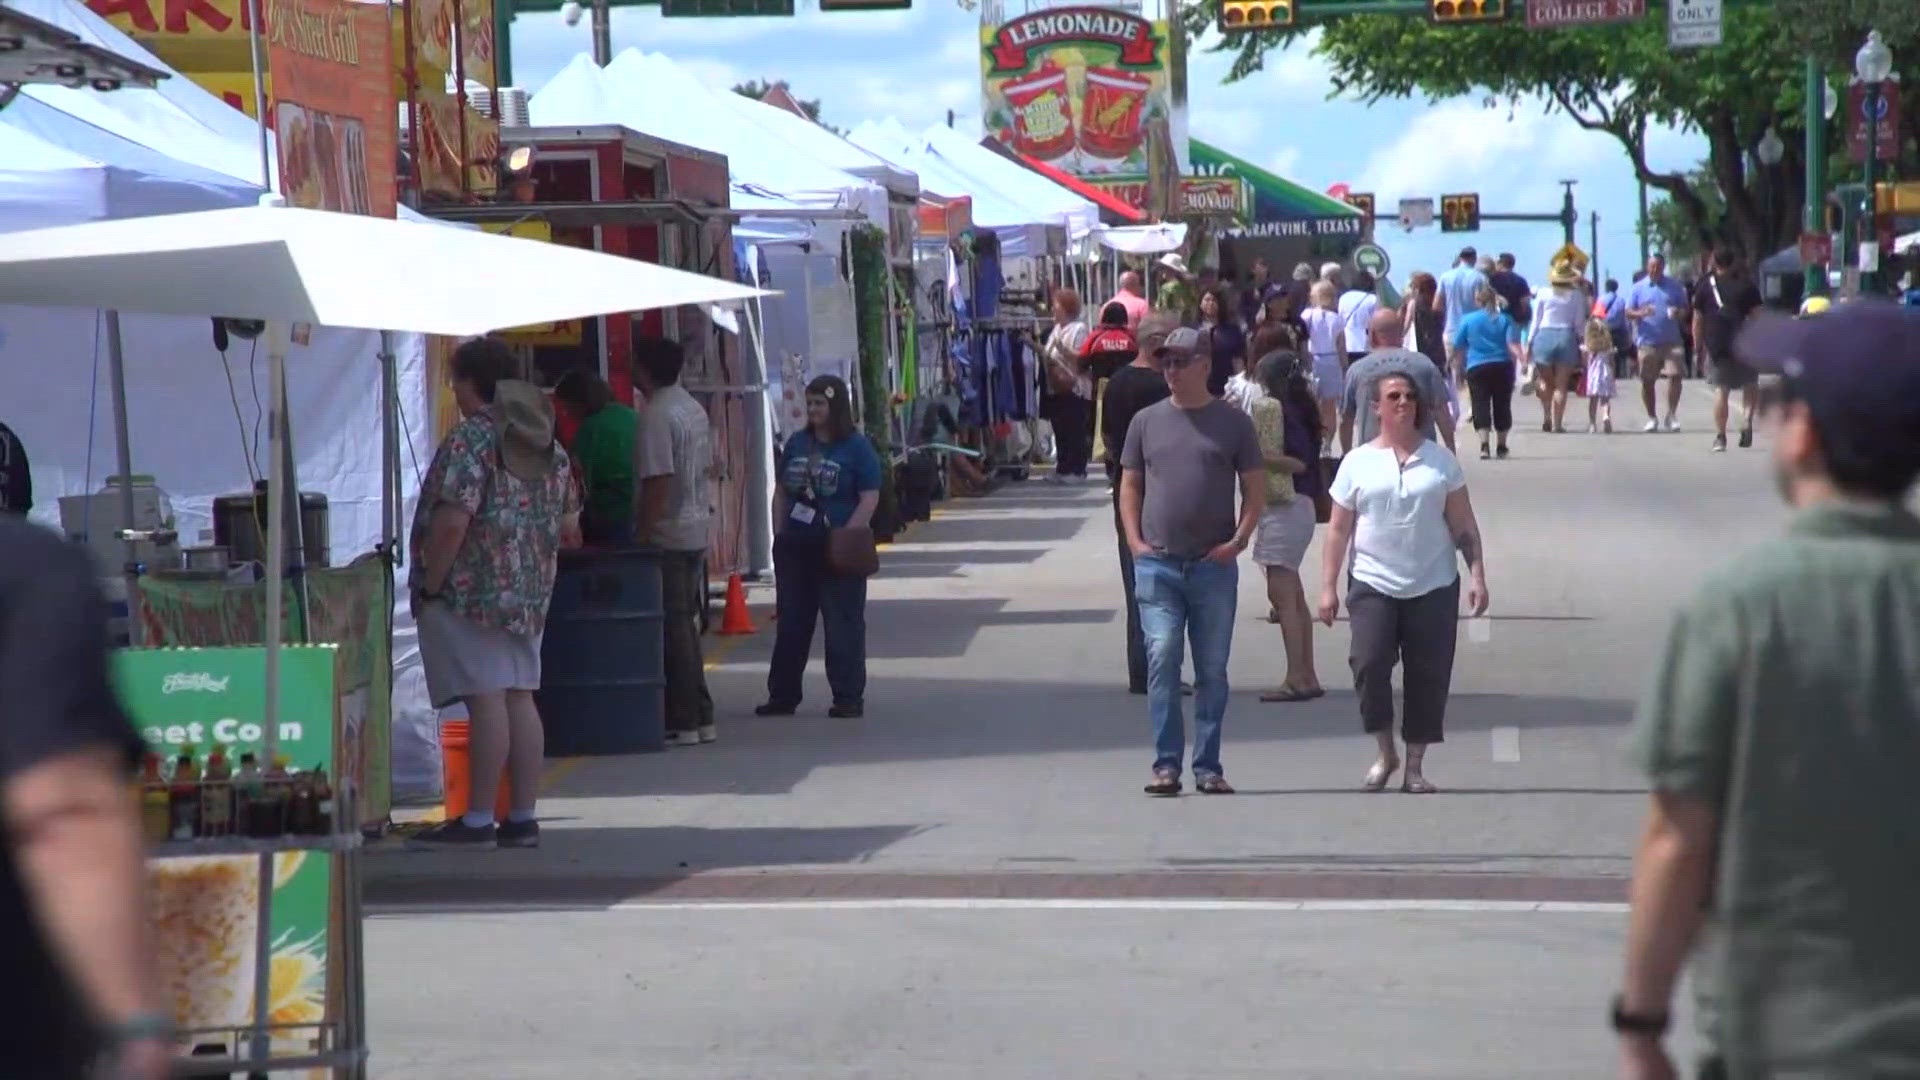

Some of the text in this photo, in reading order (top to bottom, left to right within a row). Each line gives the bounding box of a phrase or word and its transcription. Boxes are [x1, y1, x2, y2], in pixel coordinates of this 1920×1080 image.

[1534, 1, 1634, 22] COLLEGE ST
[1677, 7, 1714, 20] ONLY
[1007, 13, 1140, 45] LEMONADE
[1316, 219, 1349, 235] TEXAS
[144, 718, 302, 744] eet Con
